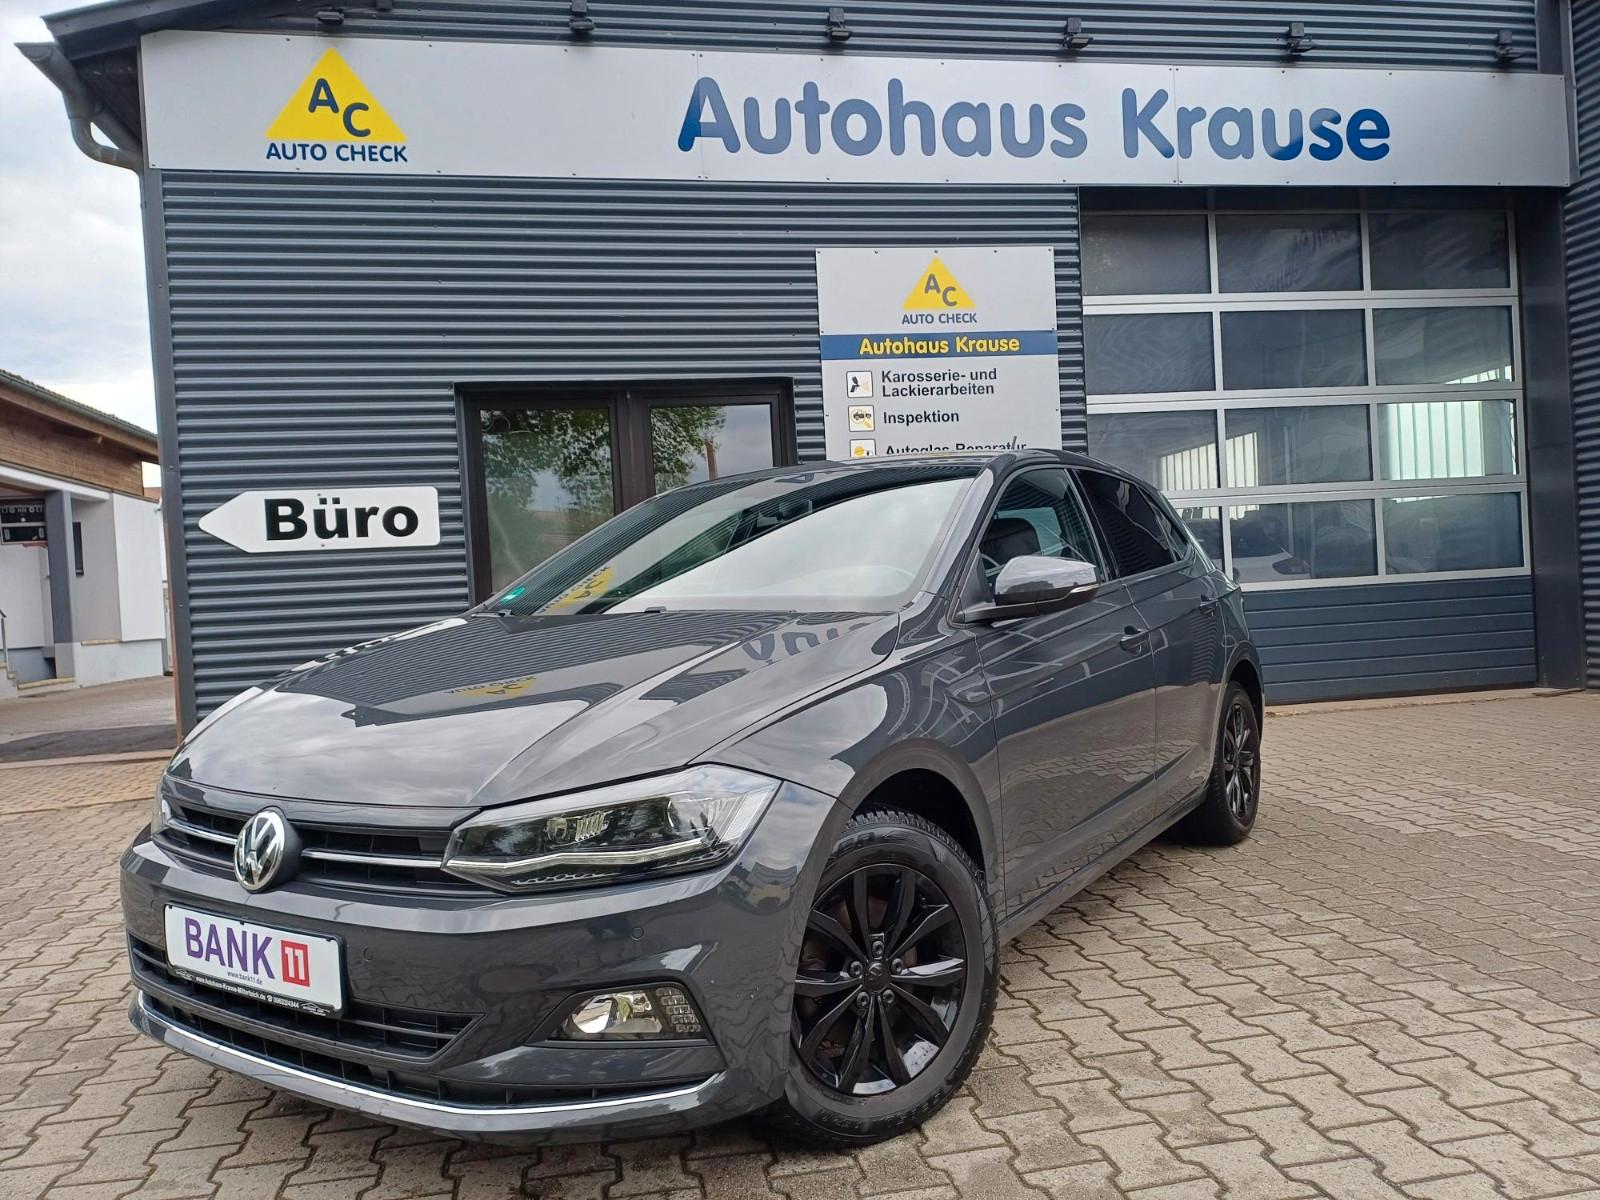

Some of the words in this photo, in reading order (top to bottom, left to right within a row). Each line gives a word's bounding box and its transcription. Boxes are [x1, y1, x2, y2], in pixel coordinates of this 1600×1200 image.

[677, 76, 1088, 159] Autohaus
[1121, 87, 1391, 161] Krause
[266, 142, 327, 161] AUTO
[335, 144, 408, 163] CHECK
[901, 313, 935, 325] AUTO
[938, 312, 978, 324] CHECK
[859, 337, 950, 356] Autohaus
[956, 335, 1020, 353] Krause
[881, 369, 966, 383] Karosserie-
[970, 367, 997, 380] und
[882, 382, 995, 398] Lackierarbeiten
[883, 410, 960, 427] Inspektion
[264, 496, 419, 541] Büro
[185, 917, 276, 980] BANK
[284, 946, 306, 981] 11
